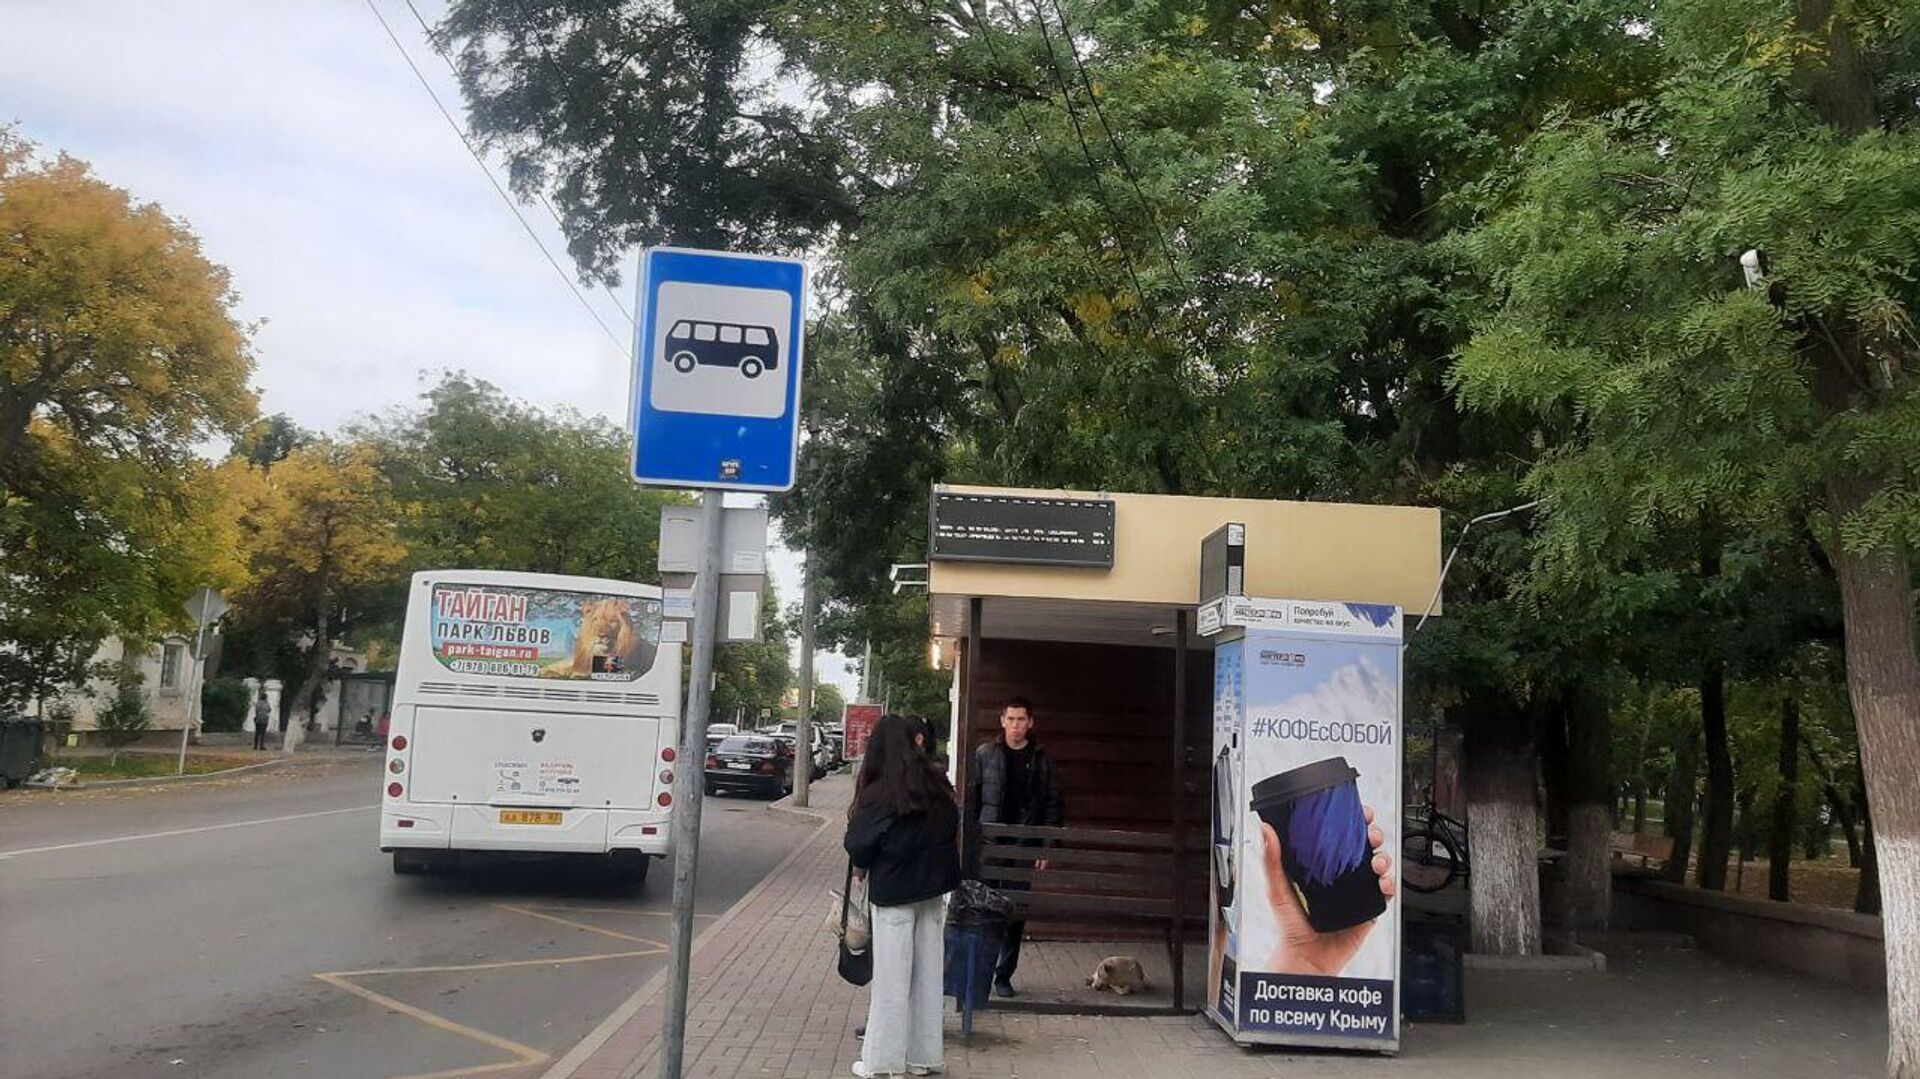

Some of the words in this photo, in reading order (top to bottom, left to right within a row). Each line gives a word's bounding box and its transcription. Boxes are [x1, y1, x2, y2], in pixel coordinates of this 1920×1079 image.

[437, 589, 525, 622] ТАЙГАН
[1294, 606, 1334, 617] Попробуй
[438, 623, 484, 640] ПАРК
[491, 625, 551, 645] ЛЬВОВ
[447, 645, 532, 659] park-taigan.ru
[1251, 718, 1392, 745] #КОФЕсСОБОЙ
[1254, 980, 1334, 1002] Доставка
[1339, 986, 1382, 1008] кофе
[1250, 1008, 1270, 1023] по
[1275, 1010, 1326, 1030] всему
[1330, 1010, 1387, 1034] Крыму
